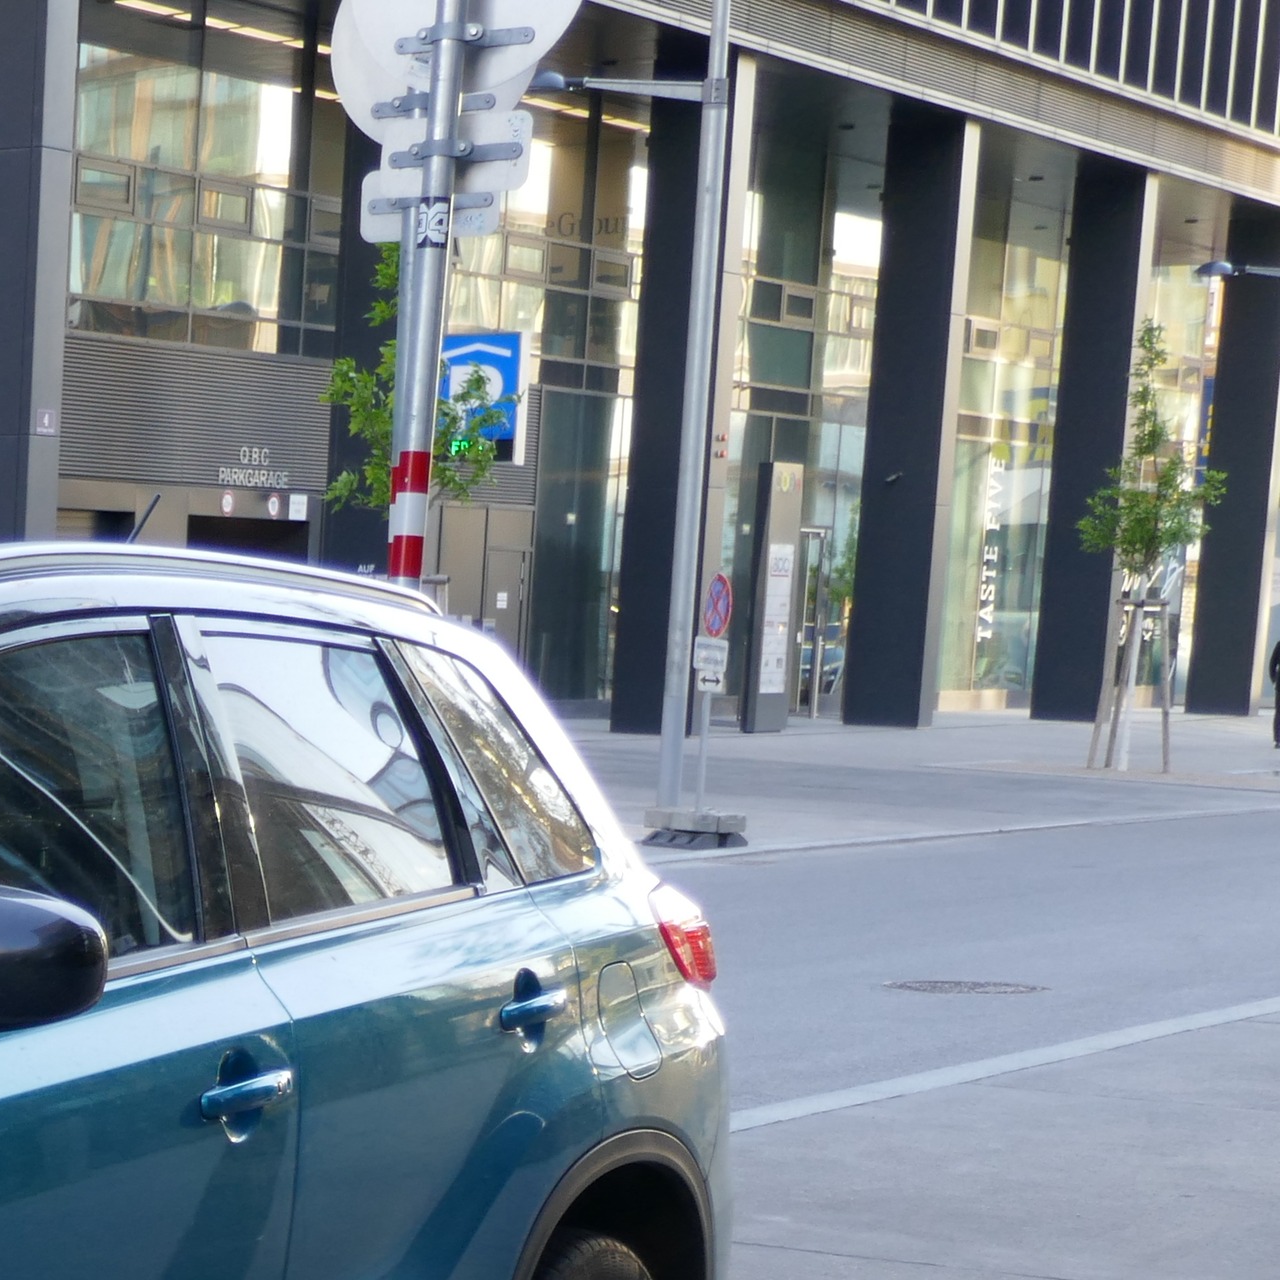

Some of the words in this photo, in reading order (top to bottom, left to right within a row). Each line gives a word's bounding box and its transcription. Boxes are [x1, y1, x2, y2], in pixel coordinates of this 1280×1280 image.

[448, 364, 504, 434] P
[219, 467, 289, 489] PARKGARAGE
[985, 456, 1006, 532] FIVE
[357, 563, 376, 573] AUF
[976, 544, 999, 642] TASTE
